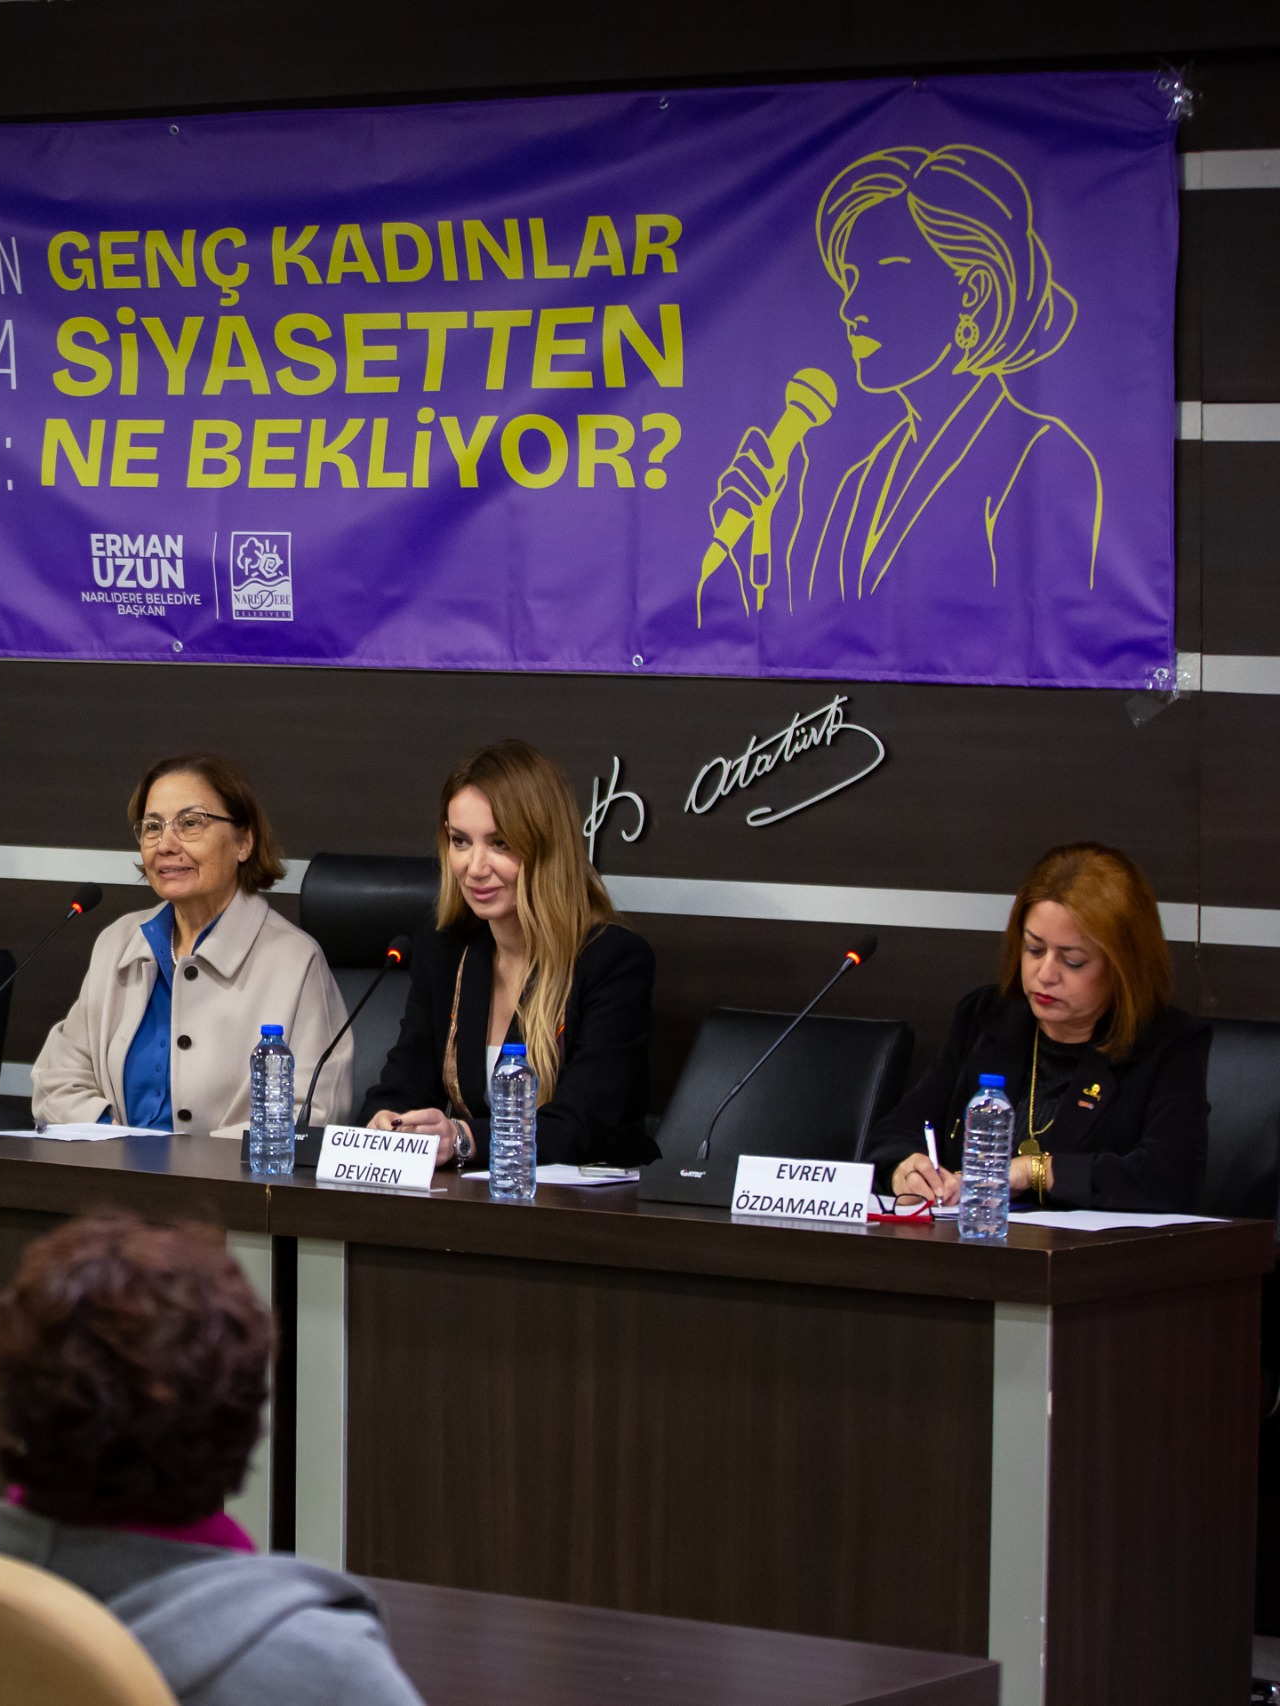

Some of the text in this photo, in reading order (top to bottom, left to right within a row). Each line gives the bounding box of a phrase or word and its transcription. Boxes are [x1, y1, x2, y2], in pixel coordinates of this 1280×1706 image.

[47, 213, 683, 307] GENÇ KADINLAR
[41, 418, 165, 488] NE
[90, 533, 184, 557] ERMAN
[92, 558, 185, 589] UZUN
[145, 590, 202, 605] BELEDİYE
[117, 604, 166, 618] BAŞKANI
[331, 1129, 392, 1151] GÜLTEN
[393, 1137, 429, 1155] ANIL
[334, 1162, 402, 1184] DEVİREN
[776, 1163, 837, 1183] EVREN
[735, 1190, 864, 1219] ÖZDAMARLAR
